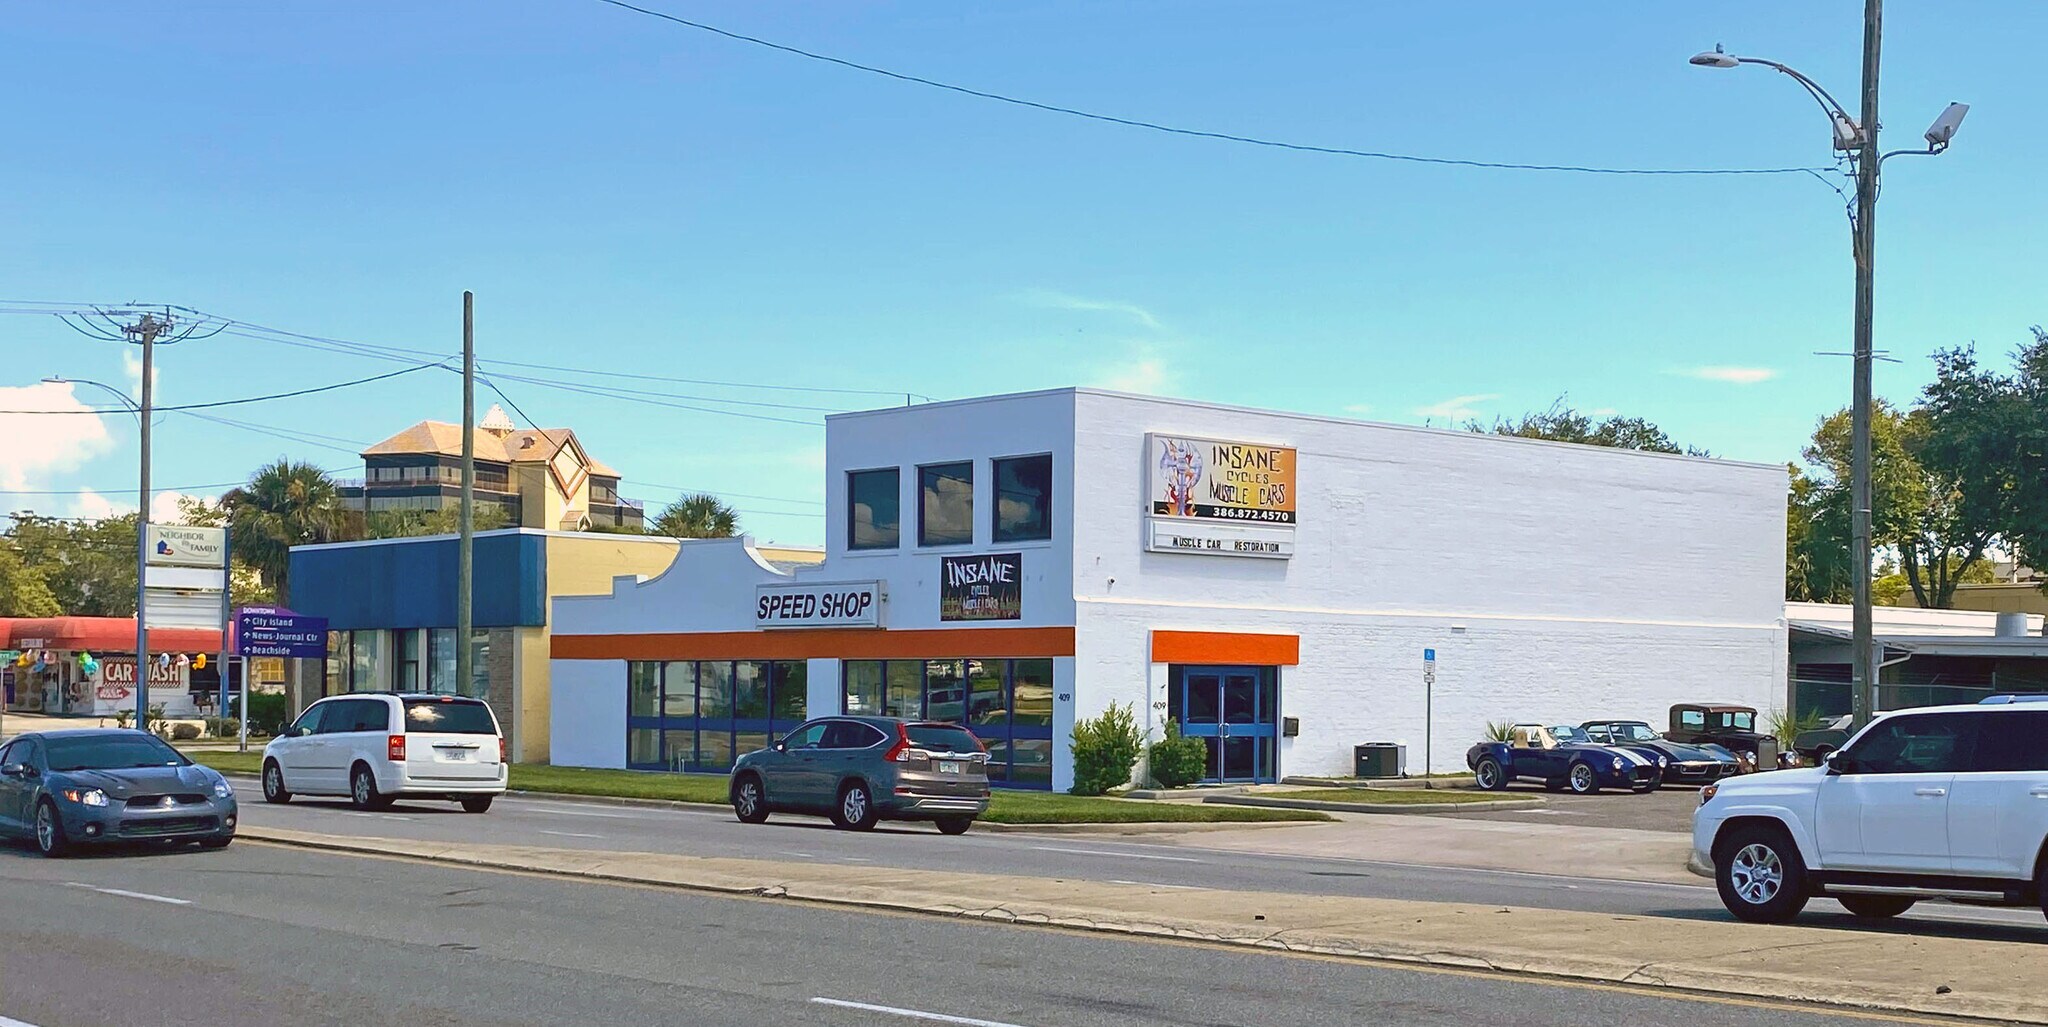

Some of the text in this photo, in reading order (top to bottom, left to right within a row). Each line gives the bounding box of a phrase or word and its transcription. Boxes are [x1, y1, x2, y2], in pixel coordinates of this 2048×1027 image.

[1212, 445, 1283, 473] INSANE
[1226, 470, 1269, 484] CYCLES
[1209, 473, 1286, 508] MUSCLE CARS
[1213, 507, 1289, 521] 386.872.4570
[160, 531, 205, 541] NEIGHBOR
[190, 544, 219, 553] FAMILY
[1172, 537, 1280, 553] MUSCLE CAR RESTORATION
[946, 556, 1015, 588] INSANE
[757, 591, 872, 619] SPEED SHOP
[252, 617, 293, 627] City Island
[252, 632, 318, 642] News-Journal Ctr
[252, 646, 291, 655] Beachside
[105, 663, 179, 682] CAR ASH
[1059, 693, 1071, 702] 409
[1152, 701, 1167, 710] 409
